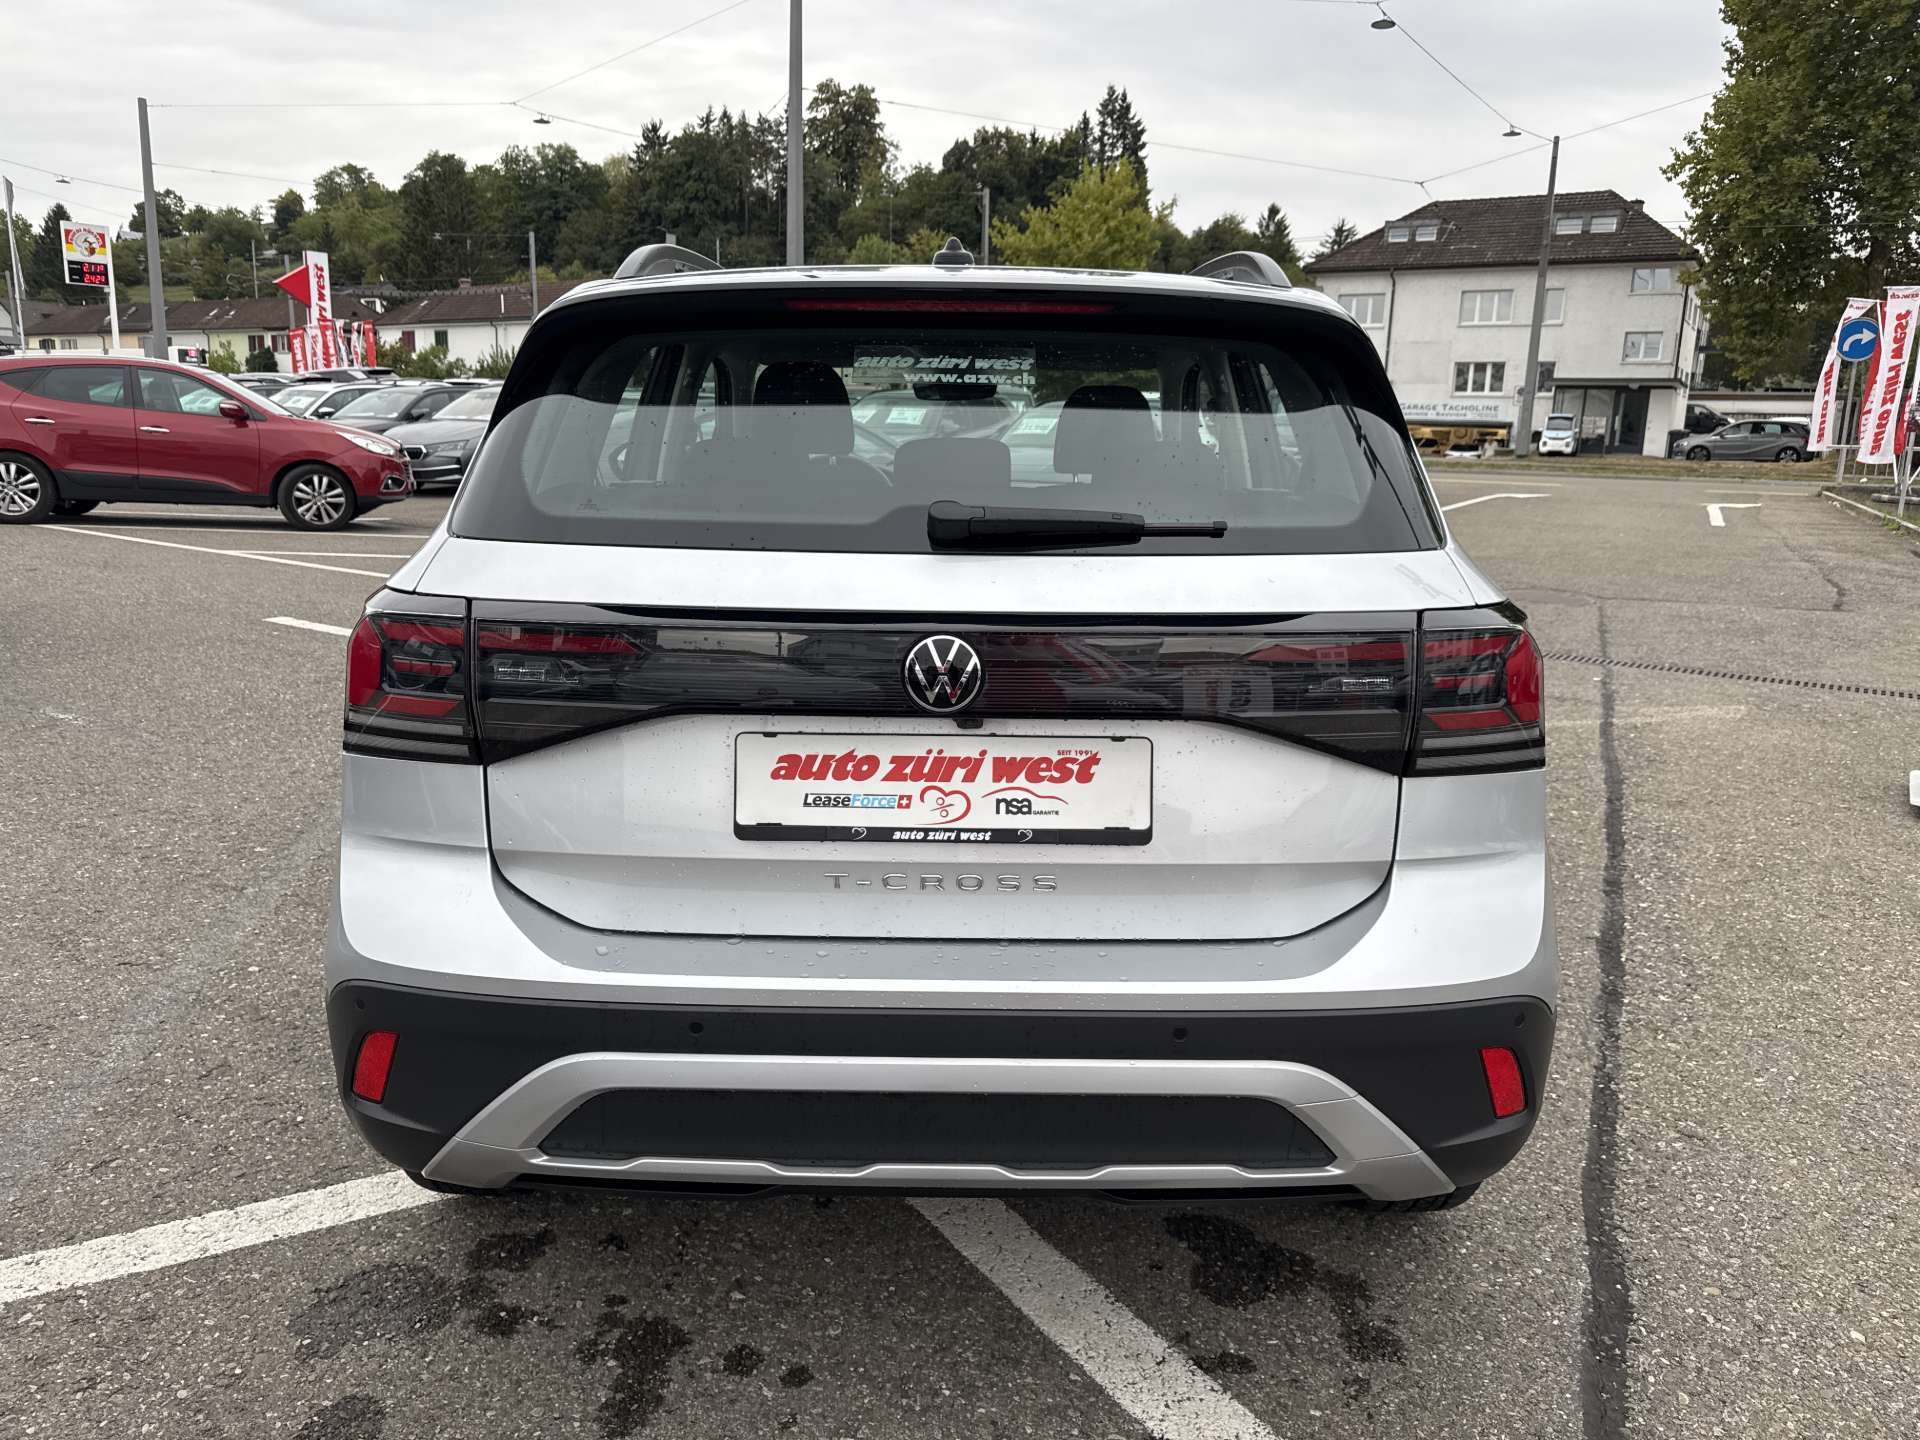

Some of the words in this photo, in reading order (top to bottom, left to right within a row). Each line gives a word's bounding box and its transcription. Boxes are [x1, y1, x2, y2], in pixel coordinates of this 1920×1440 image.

[854, 355, 915, 368] auto
[915, 355, 972, 369] züri
[974, 357, 1035, 370] west
[903, 372, 1036, 384] www.azw.ch
[770, 749, 880, 782] auto
[880, 749, 988, 783] züri
[992, 752, 1102, 784] west
[803, 792, 897, 809] LeaseForce
[996, 798, 1032, 815] nsa
[892, 831, 924, 840] auto
[927, 830, 957, 841] züri
[960, 831, 991, 841] west
[823, 873, 1058, 892] T-CROSS
